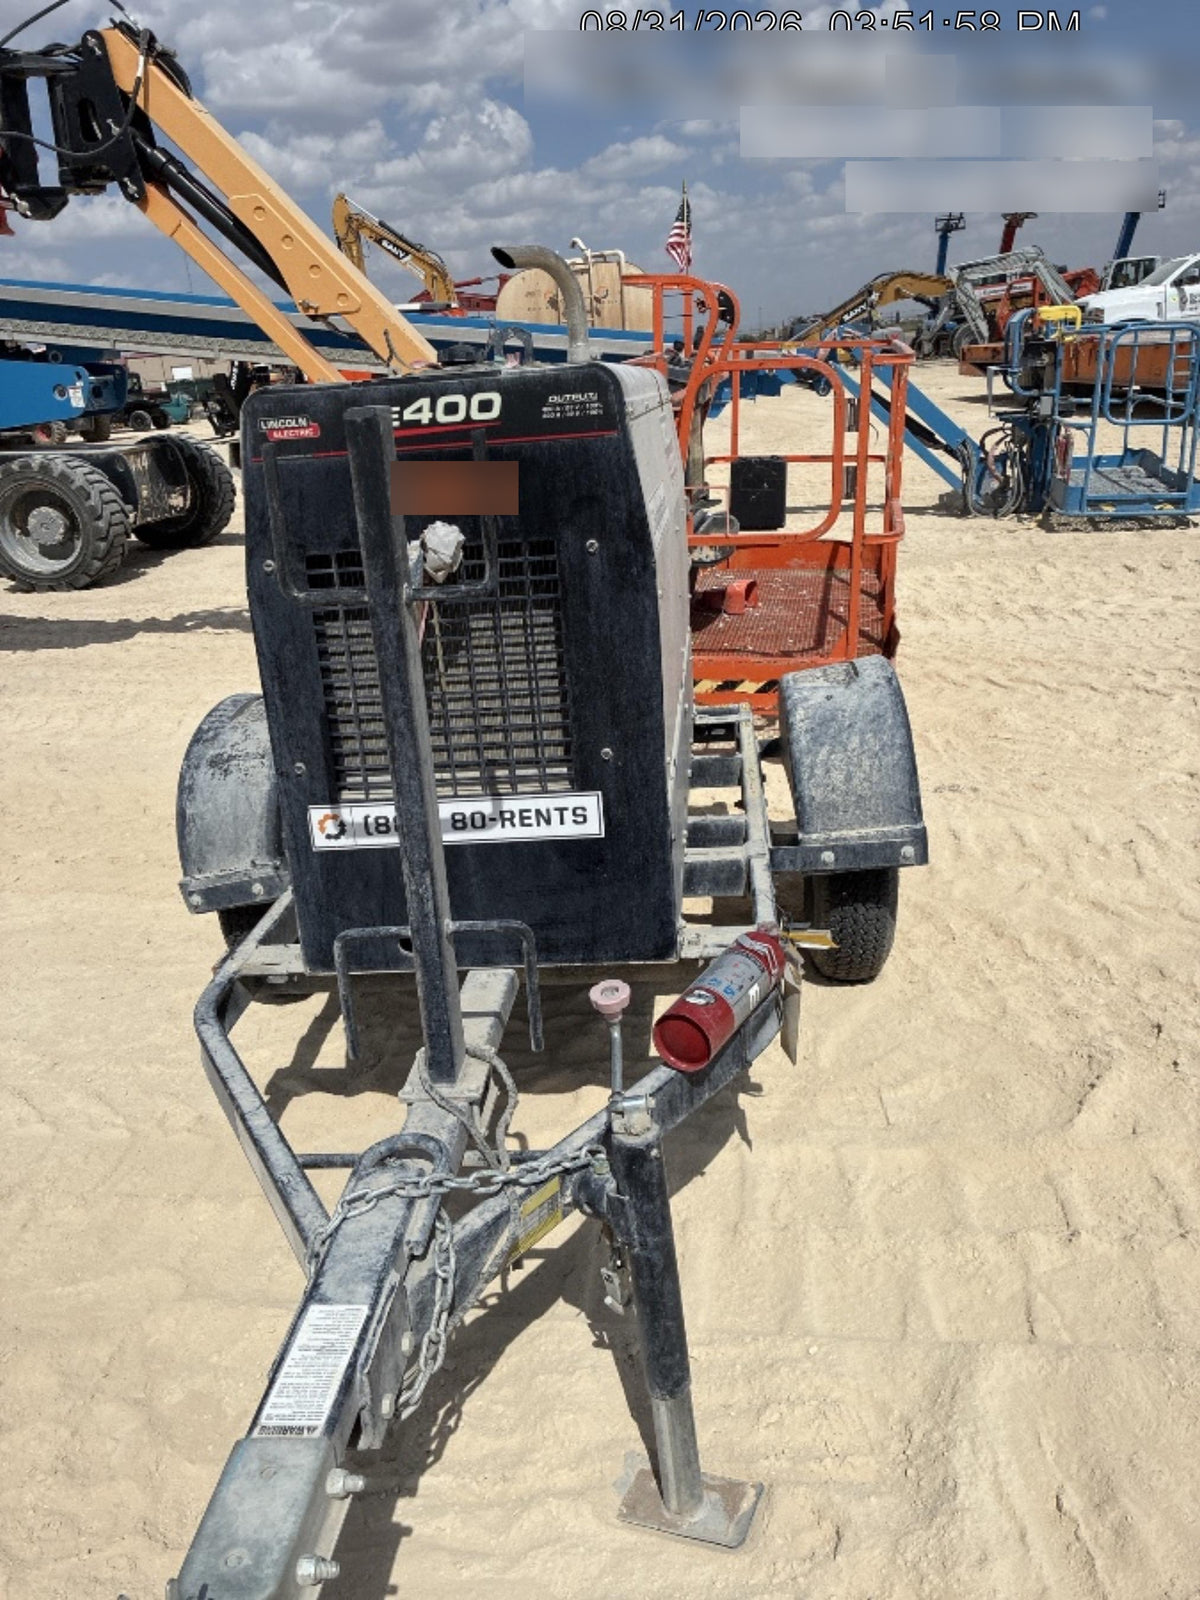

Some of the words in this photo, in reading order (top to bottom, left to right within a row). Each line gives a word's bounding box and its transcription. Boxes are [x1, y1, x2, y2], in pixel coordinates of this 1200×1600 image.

[260, 417, 307, 430] LINCOLN
[273, 427, 314, 439] ELECTRIC
[450, 806, 588, 831] 80-RENTS
